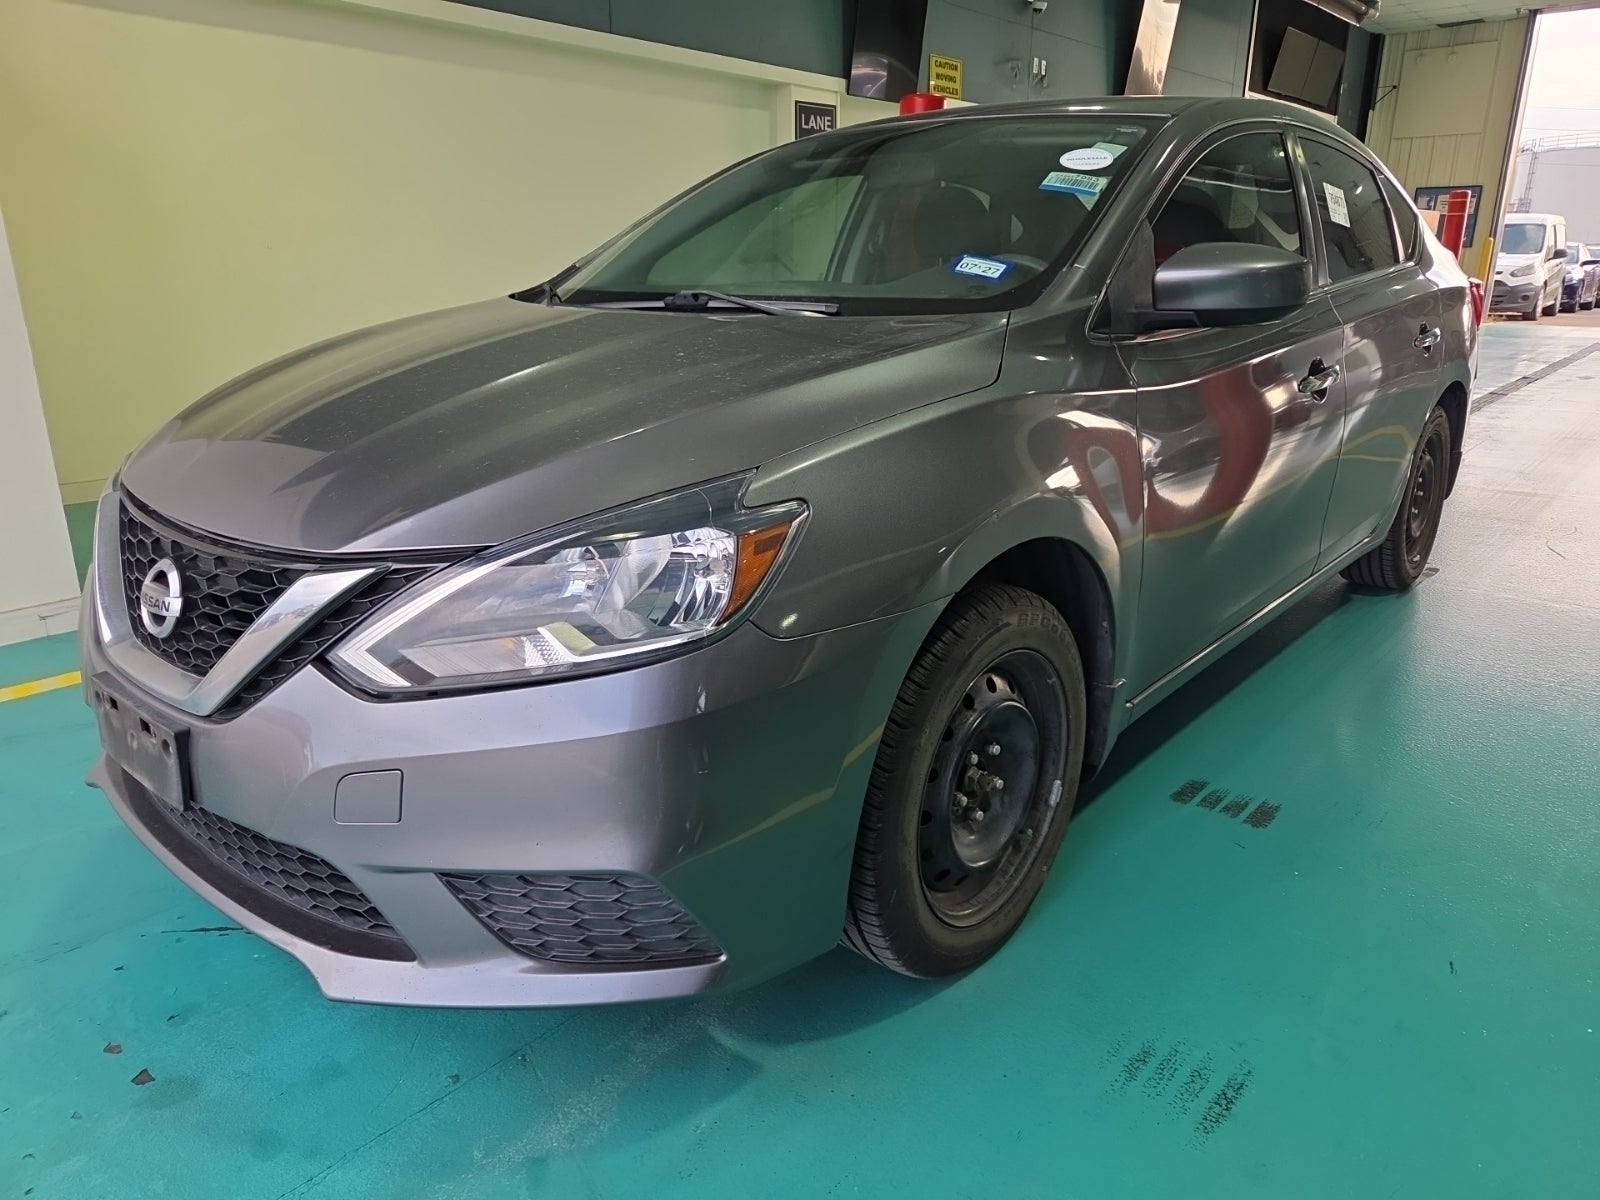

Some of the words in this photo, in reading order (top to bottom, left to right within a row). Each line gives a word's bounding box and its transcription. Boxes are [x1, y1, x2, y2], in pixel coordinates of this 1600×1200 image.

[934, 59, 959, 71] CAUTION
[935, 73, 957, 84] MOVING
[932, 84, 959, 96] VEHICLES
[801, 113, 832, 131] LANE
